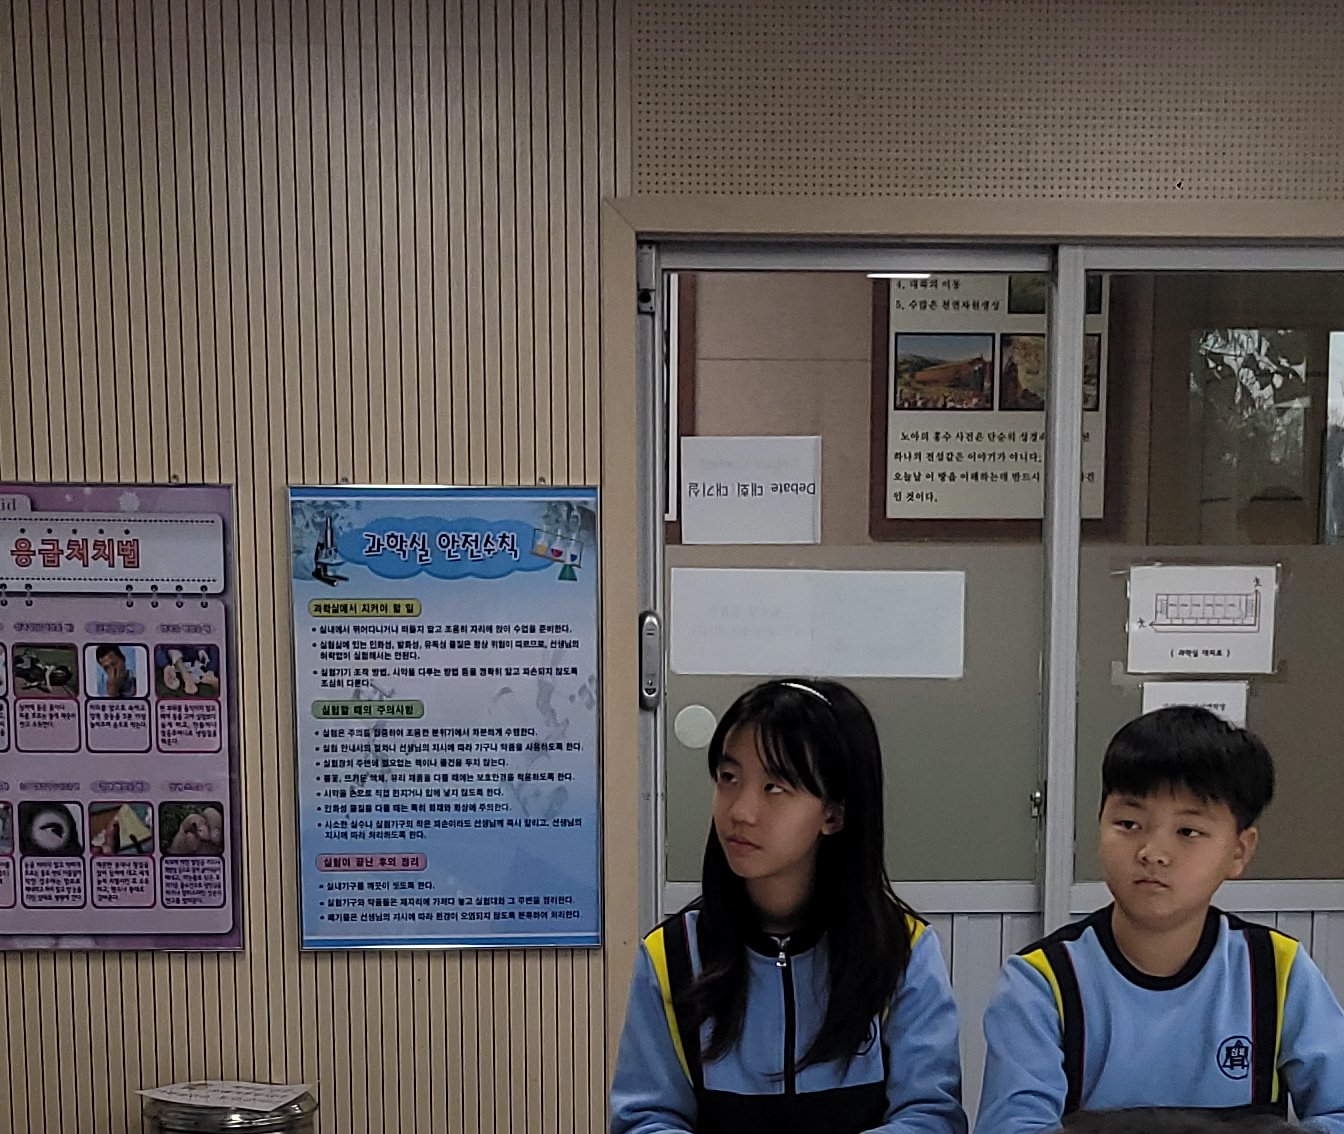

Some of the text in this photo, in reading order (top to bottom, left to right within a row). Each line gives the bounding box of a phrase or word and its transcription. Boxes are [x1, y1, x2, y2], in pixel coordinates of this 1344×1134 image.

[900, 431, 929, 442] 노아의
[932, 431, 952, 442] 홍수
[956, 431, 984, 442] 사건은
[987, 431, 1016, 442] 단순히
[894, 451, 1042, 462] 하나의 전설같은 이야기가 아니다.
[893, 472, 922, 482] 오늘날
[925, 472, 934, 482] 이
[960, 472, 1008, 482] 이해하는데
[1011, 472, 1040, 482] 반드시
[688, 482, 816, 498] Debate 대회 대기실
[906, 491, 938, 503] 것이다.
[10, 537, 140, 569] 응급처치법
[363, 531, 521, 565] 과학실 안전수칙
[314, 603, 356, 613] 과학실에서
[406, 603, 414, 613] 일
[427, 625, 442, 634] 말고
[470, 625, 493, 634] 자리에
[514, 625, 535, 634] 수업을
[539, 625, 572, 634] 준비한다.
[320, 641, 349, 649] 실험실에
[353, 641, 366, 649] 있는
[491, 640, 512, 649] 위험이
[550, 640, 579, 649] 선생님의
[419, 668, 440, 677] 다루는
[322, 706, 413, 715] 실험할 때의 주의사항
[458, 743, 472, 751] 따라
[475, 743, 497, 751] 기구나
[552, 818, 581, 828] 선생님의
[324, 858, 418, 868] 실험이 끝난 후의 정리
